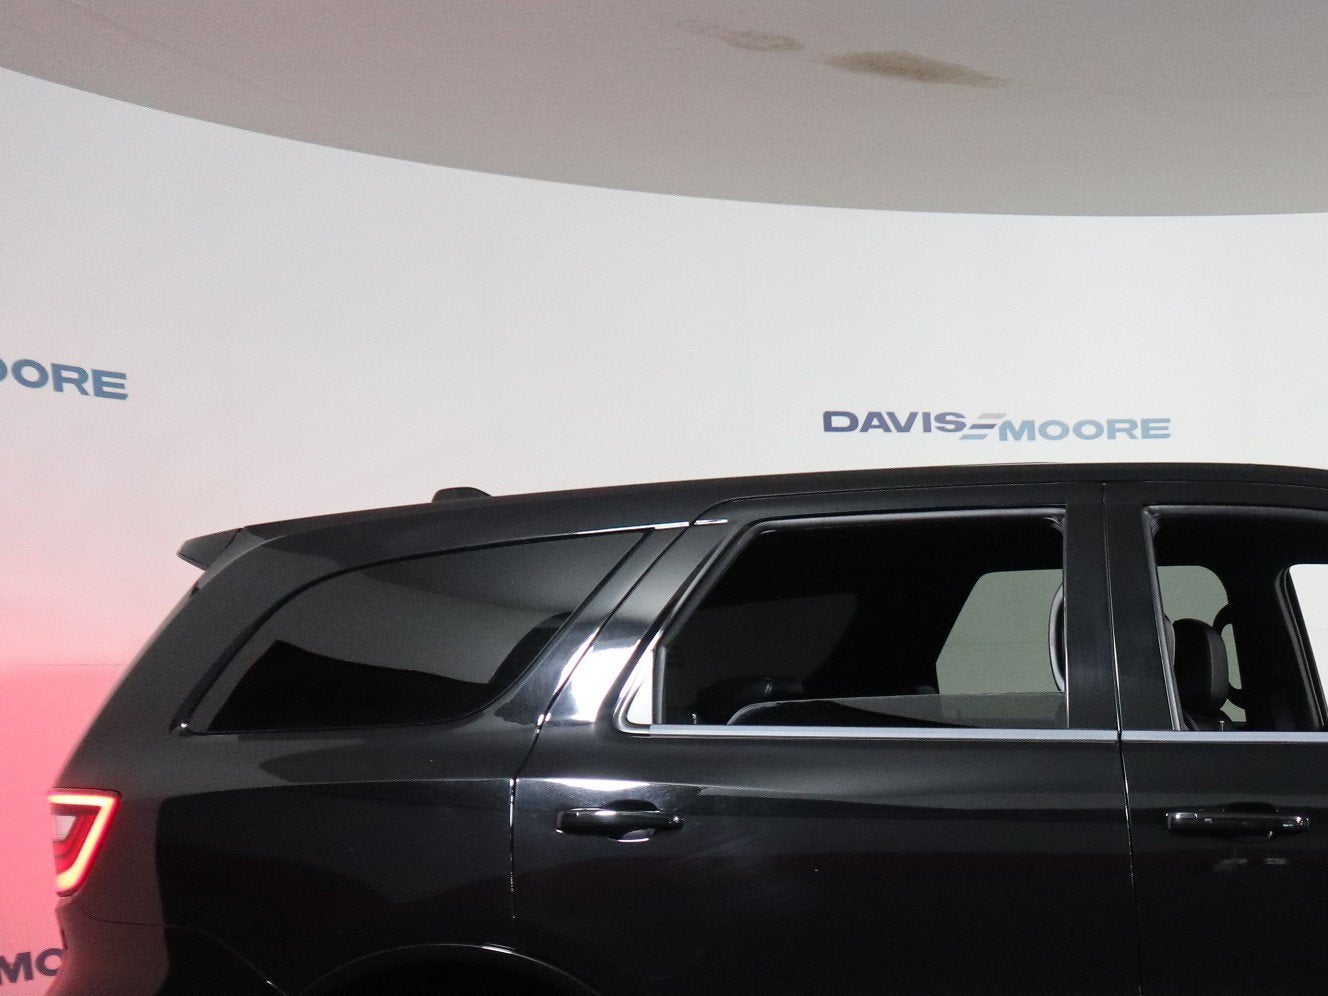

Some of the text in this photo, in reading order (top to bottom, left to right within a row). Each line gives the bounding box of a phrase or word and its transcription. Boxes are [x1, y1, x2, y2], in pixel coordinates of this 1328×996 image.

[0, 358, 128, 400] ORE
[823, 411, 1171, 441] DAVIS MOORE
